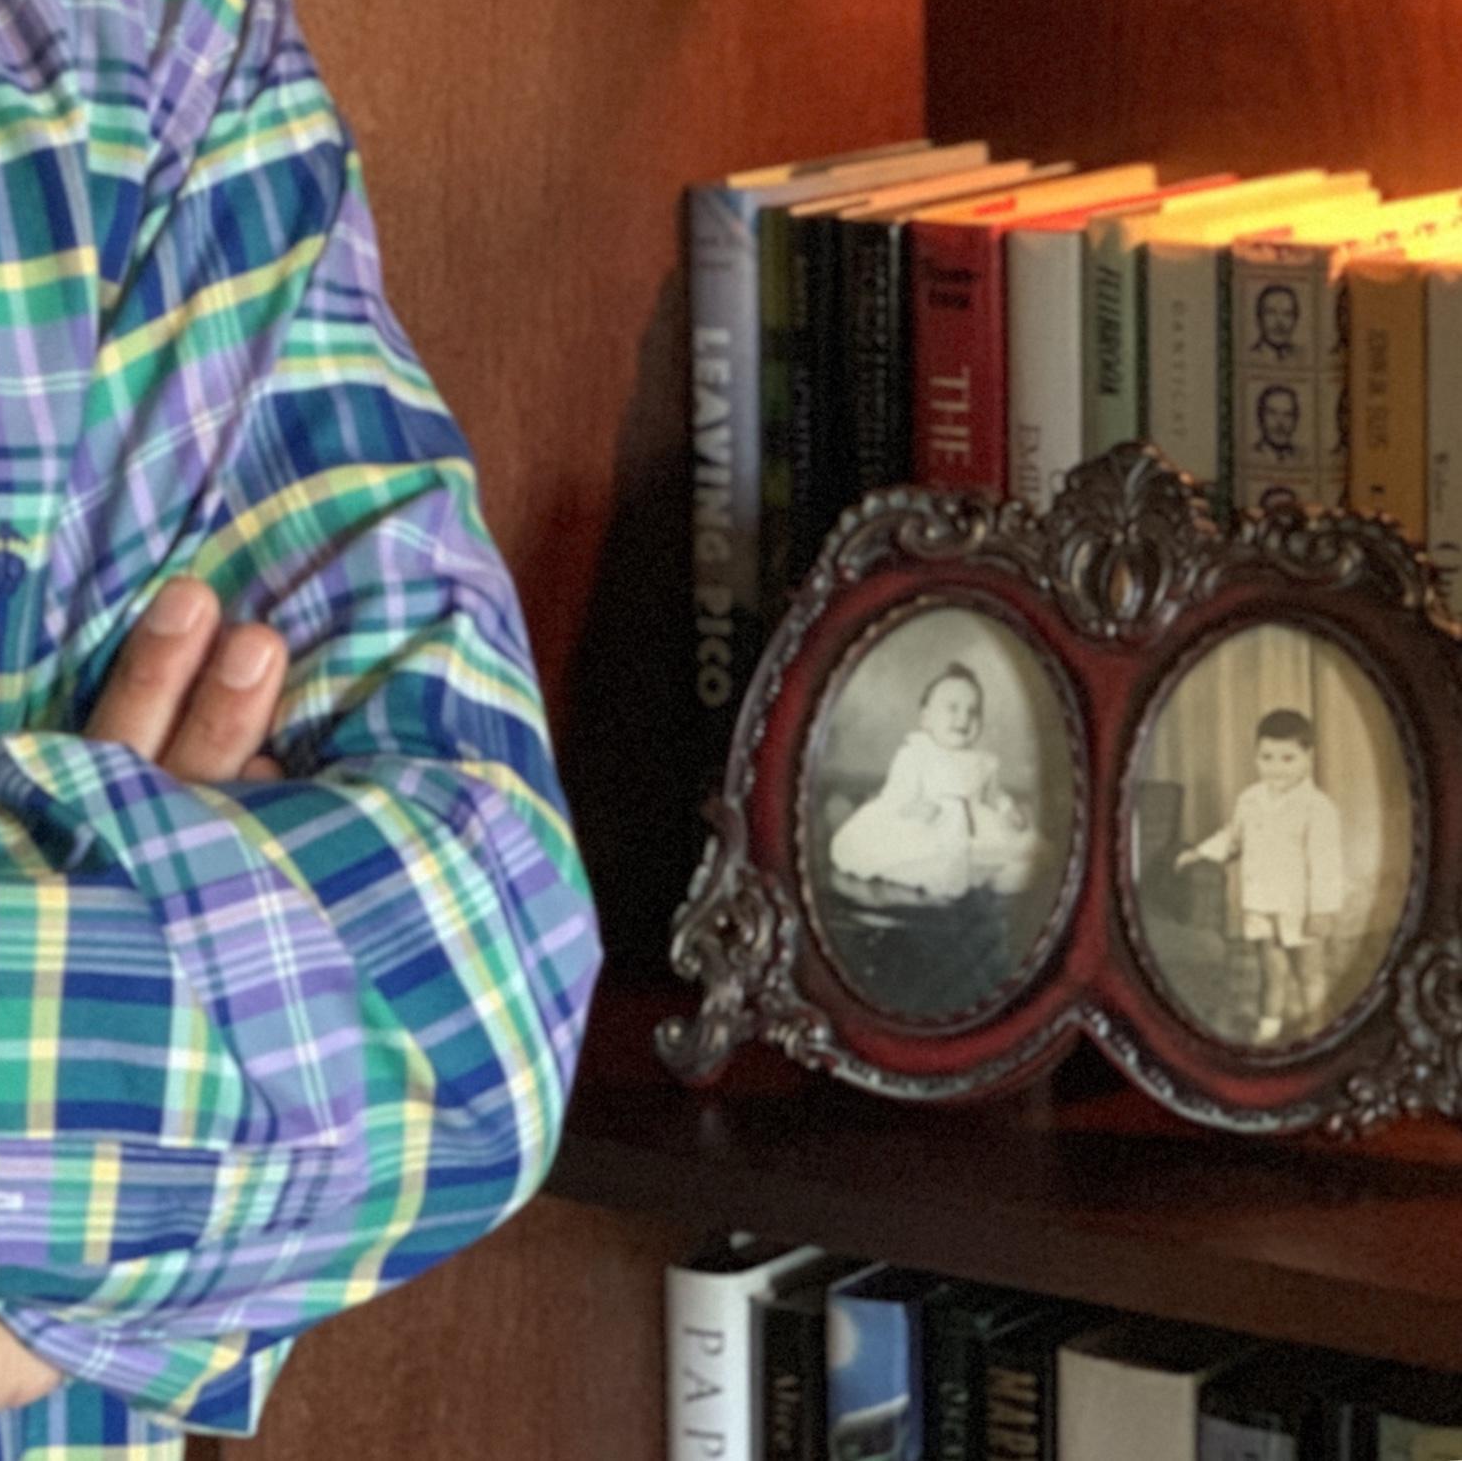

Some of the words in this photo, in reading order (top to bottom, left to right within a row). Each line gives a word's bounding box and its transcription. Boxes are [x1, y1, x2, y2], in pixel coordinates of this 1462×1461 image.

[693, 327, 734, 564] LEAVING
[928, 365, 971, 468] THE
[696, 585, 733, 708] PICO
[986, 1366, 1038, 1461] MAR
